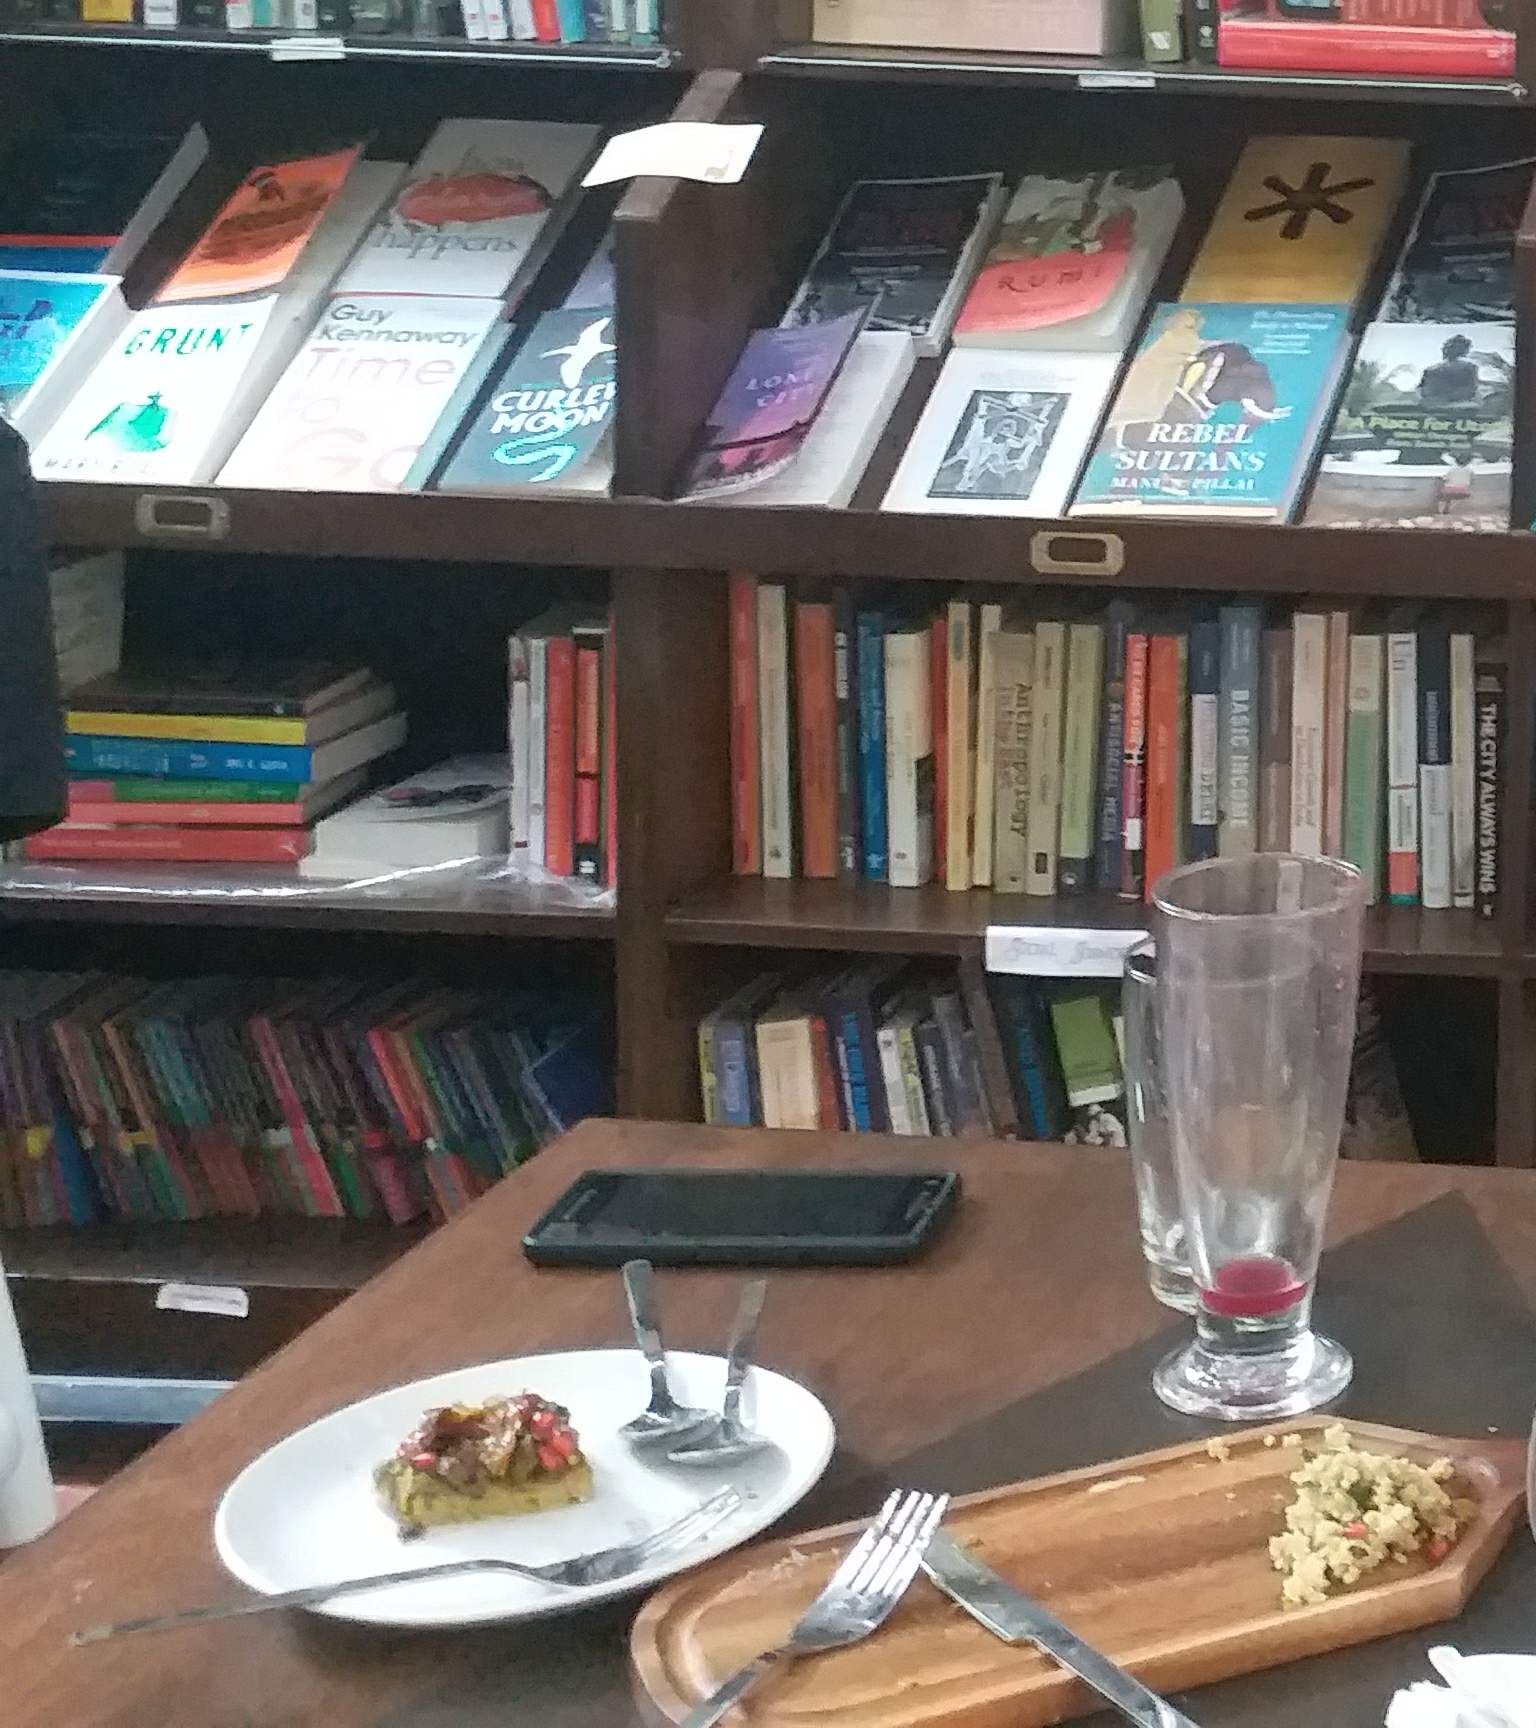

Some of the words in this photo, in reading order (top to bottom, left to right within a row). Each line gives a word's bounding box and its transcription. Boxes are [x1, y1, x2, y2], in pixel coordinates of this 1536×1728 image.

[331, 301, 394, 327] Guy
[124, 323, 255, 356] GRUNT
[318, 324, 482, 351] Kennaway
[304, 345, 458, 387] Time
[490, 401, 610, 434] MOON
[1146, 423, 1254, 444] REBEL
[1111, 450, 1267, 473] SULTANS
[1230, 689, 1250, 747] BASIC
[1480, 703, 1498, 737] THE
[1009, 682, 1034, 839] Anthropology
[1480, 738, 1498, 780] CITY
[1229, 755, 1250, 829] INCOME
[1480, 780, 1498, 847] ALWAYS
[1479, 848, 1497, 894] WINS
